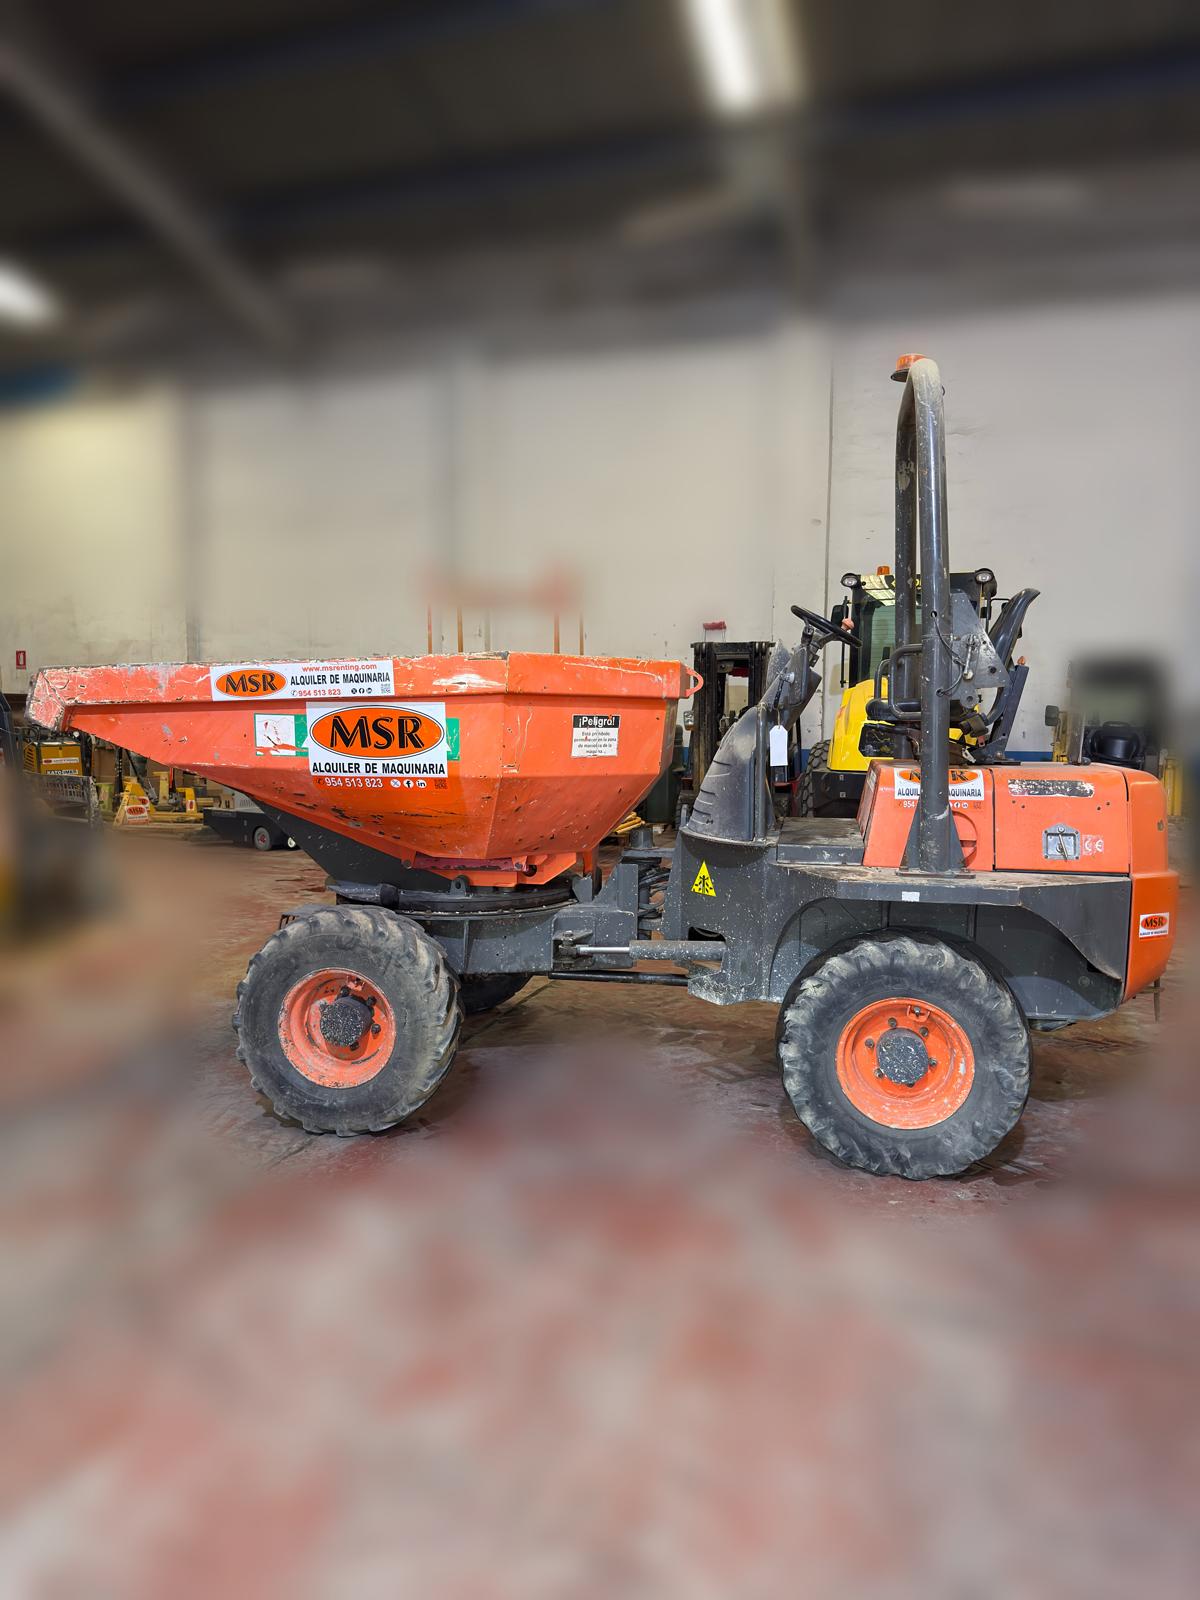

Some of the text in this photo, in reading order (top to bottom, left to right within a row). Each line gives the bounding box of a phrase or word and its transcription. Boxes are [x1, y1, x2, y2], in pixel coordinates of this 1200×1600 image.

[302, 663, 377, 673] www.msrenting.com
[225, 672, 278, 693] MSR
[290, 672, 390, 686] ALQUILER DE MAQUINARIA
[297, 689, 311, 697] 954
[328, 688, 341, 696] 823
[579, 716, 615, 728] ¡Peligro!
[330, 716, 424, 750] MSR
[312, 762, 446, 775] ALQUILER DE MAQUINARIA
[325, 777, 383, 789] 954 513 823
[897, 788, 981, 797] ALQUIL AQUINARIA
[903, 800, 915, 808] 954
[1144, 916, 1164, 928] MSR
